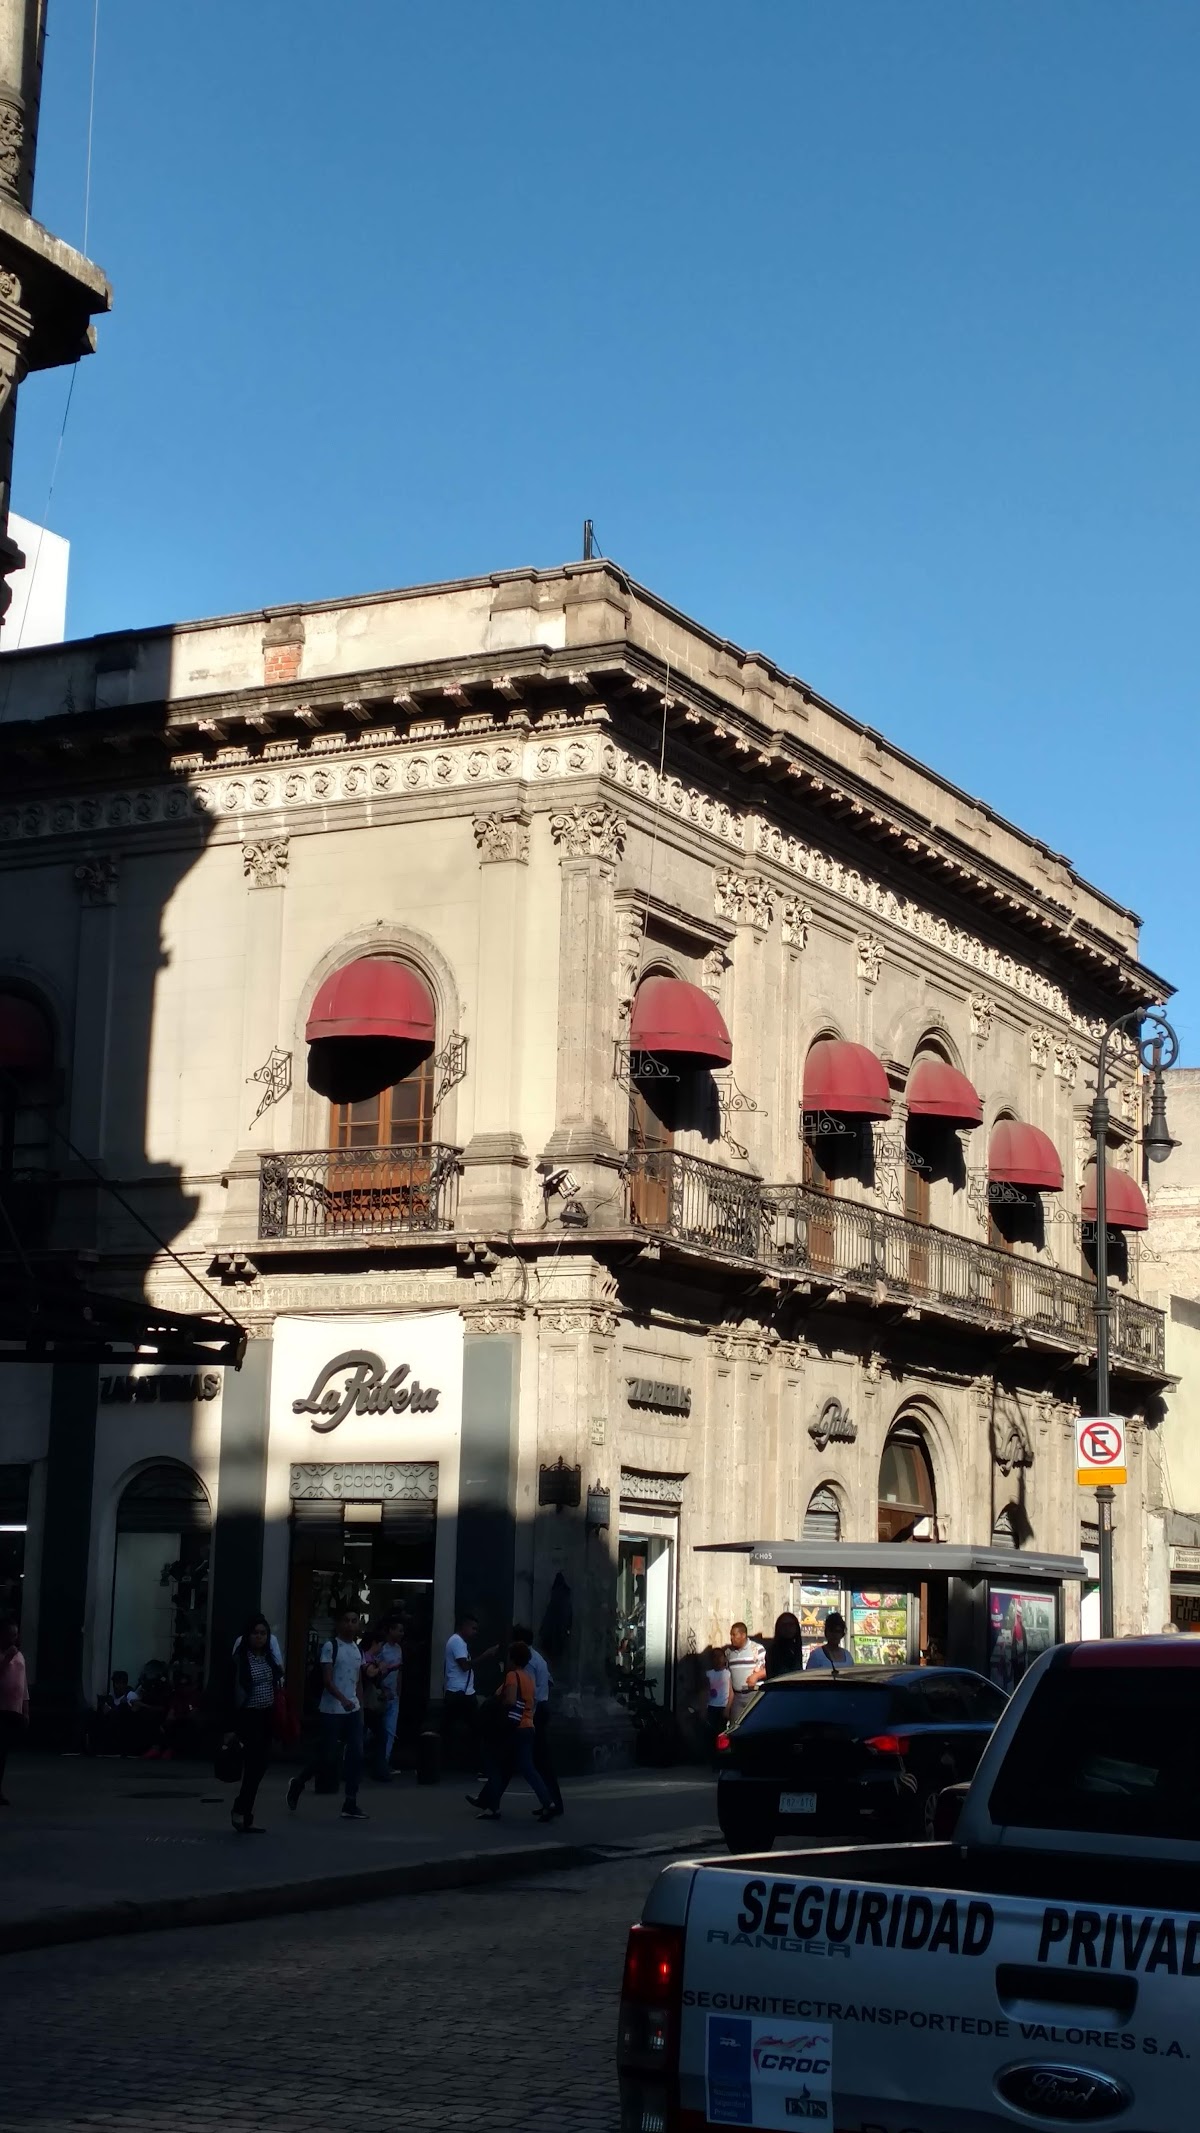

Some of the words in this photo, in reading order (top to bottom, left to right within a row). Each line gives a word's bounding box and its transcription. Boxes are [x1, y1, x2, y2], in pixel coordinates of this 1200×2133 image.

[311, 1349, 442, 1433] Ribera
[738, 1880, 994, 1956] SEGURIDAD
[707, 1930, 851, 1958] RANGER
[1020, 2023, 1136, 2051] VALORES
[1142, 2037, 1191, 2059] S.A.
[761, 2054, 831, 2075] CROC
[1024, 2072, 1097, 2105] Ford
